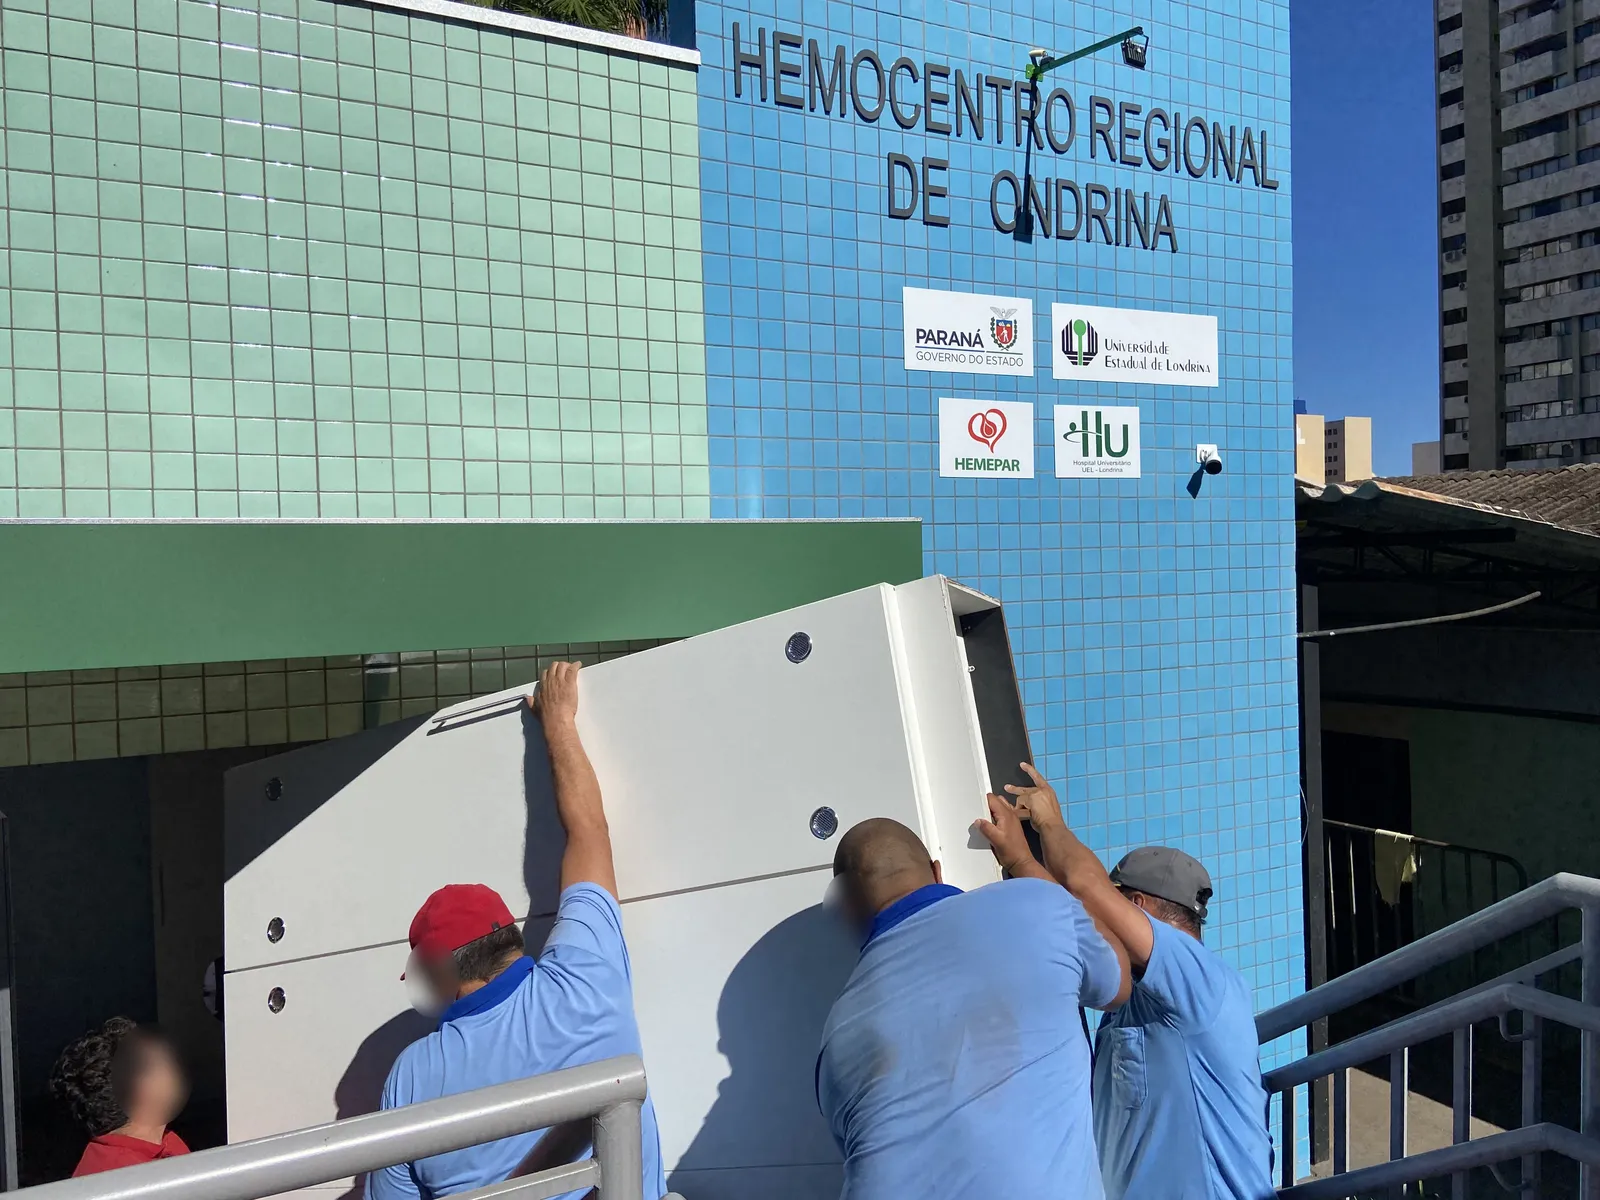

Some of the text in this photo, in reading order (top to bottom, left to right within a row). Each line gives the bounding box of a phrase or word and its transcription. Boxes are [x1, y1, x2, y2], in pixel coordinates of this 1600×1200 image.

[732, 21, 1279, 190] HEMOCENTRO REGIONAL
[887, 151, 1178, 254] DE ONDRINA
[916, 328, 984, 348] PARANÁ
[1104, 338, 1170, 355] Universidade
[916, 351, 1024, 367] GOVERNO DO ESTADO
[1105, 355, 1211, 373] Estadual de Londrina
[954, 457, 1020, 472] HEMEPAR
